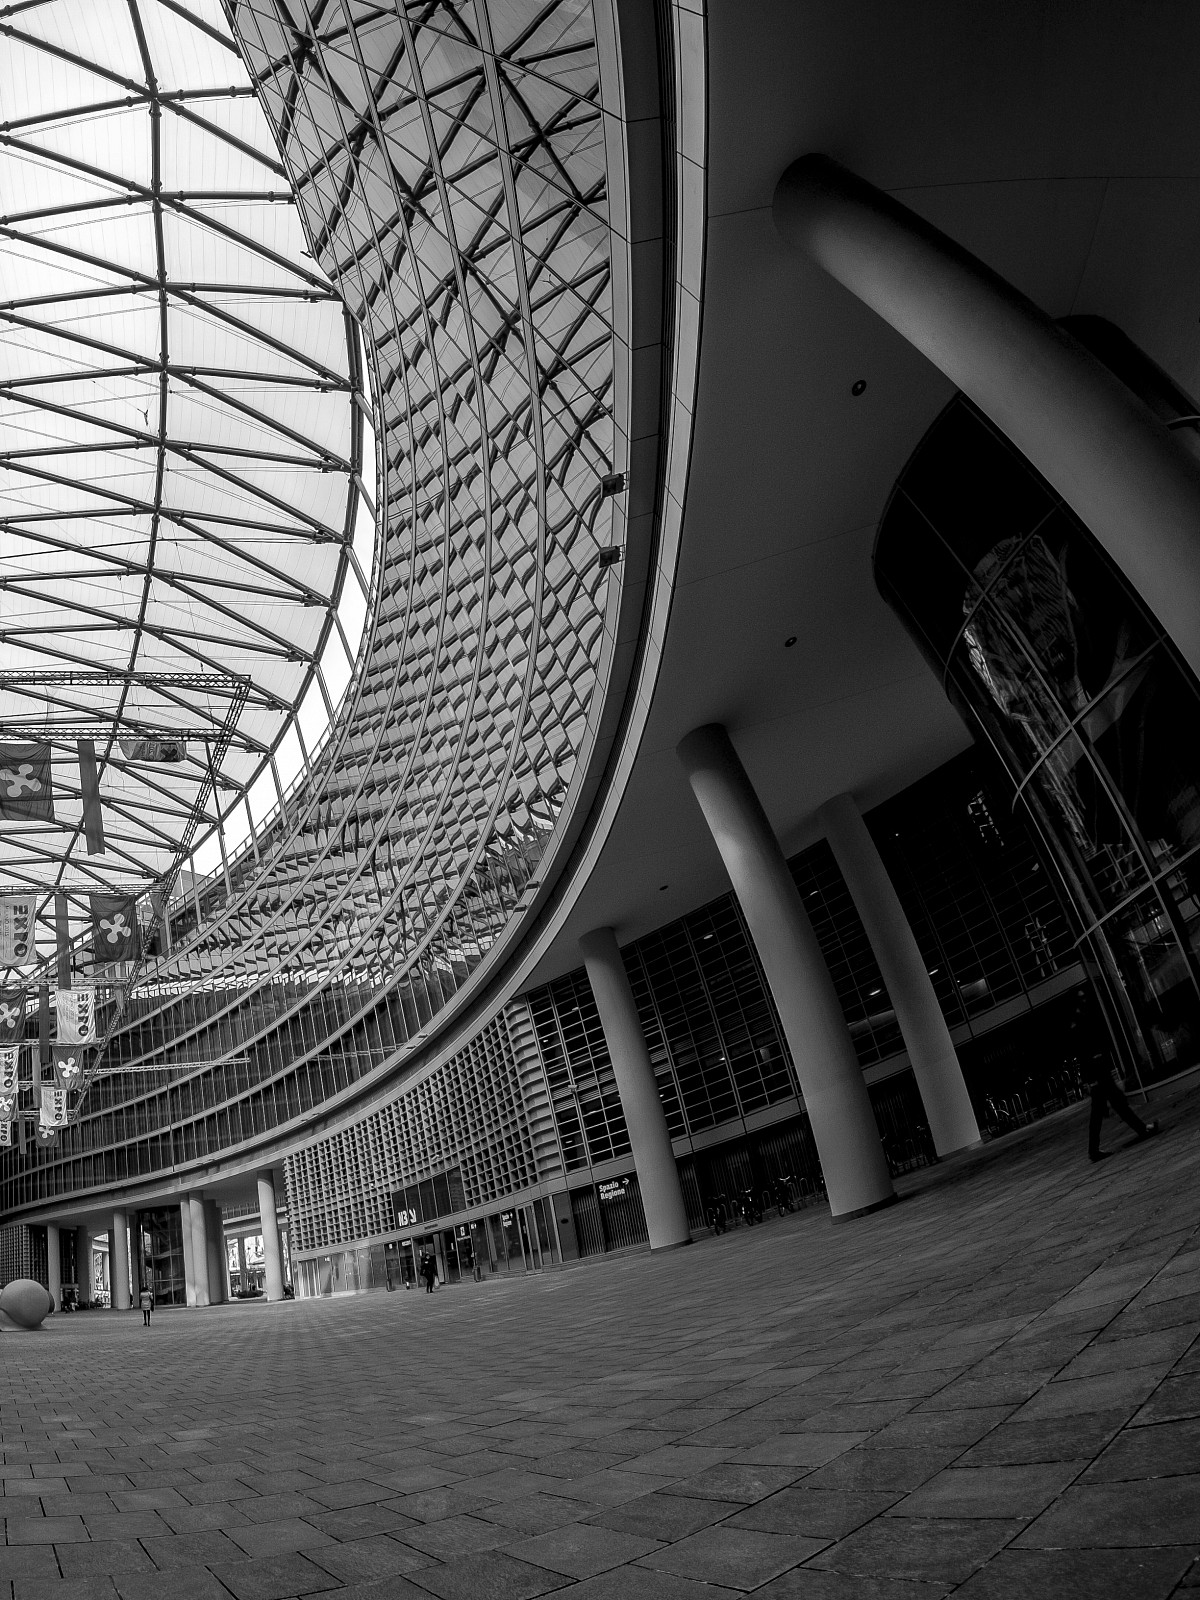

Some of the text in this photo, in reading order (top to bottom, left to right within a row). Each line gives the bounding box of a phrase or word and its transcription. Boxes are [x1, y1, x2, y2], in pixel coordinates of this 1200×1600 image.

[13, 905, 28, 957] EXPO
[77, 993, 89, 1036] EXPO
[3, 1053, 14, 1088] EXPO
[54, 1091, 63, 1120] EXPO
[0, 1120, 8, 1141] XPO
[599, 1181, 619, 1193] Spazio
[600, 1188, 626, 1200] Regione
